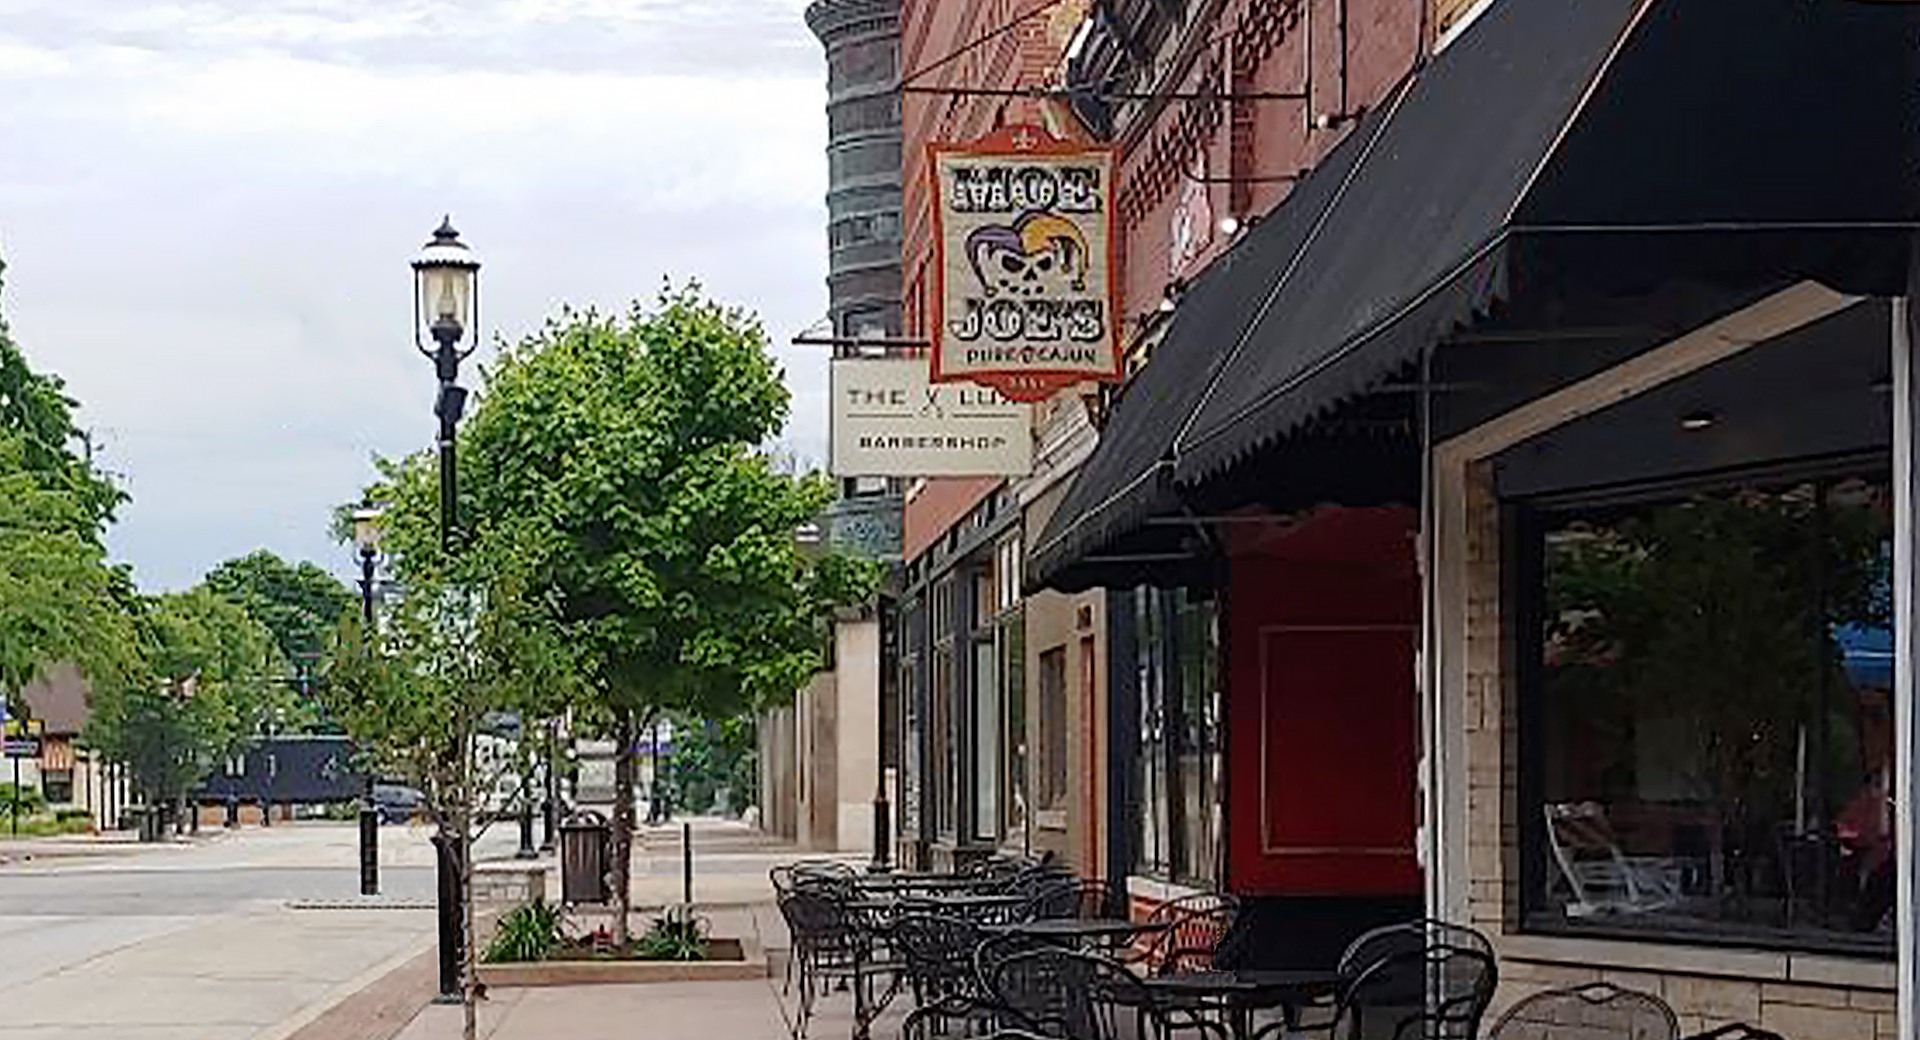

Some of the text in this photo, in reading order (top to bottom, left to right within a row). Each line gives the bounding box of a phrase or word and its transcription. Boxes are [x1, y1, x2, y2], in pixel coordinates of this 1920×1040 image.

[952, 167, 1103, 212] MOE
[949, 299, 1104, 342] JOE'S
[847, 389, 905, 405] THE
[859, 436, 1006, 450] BARBERSHOP
